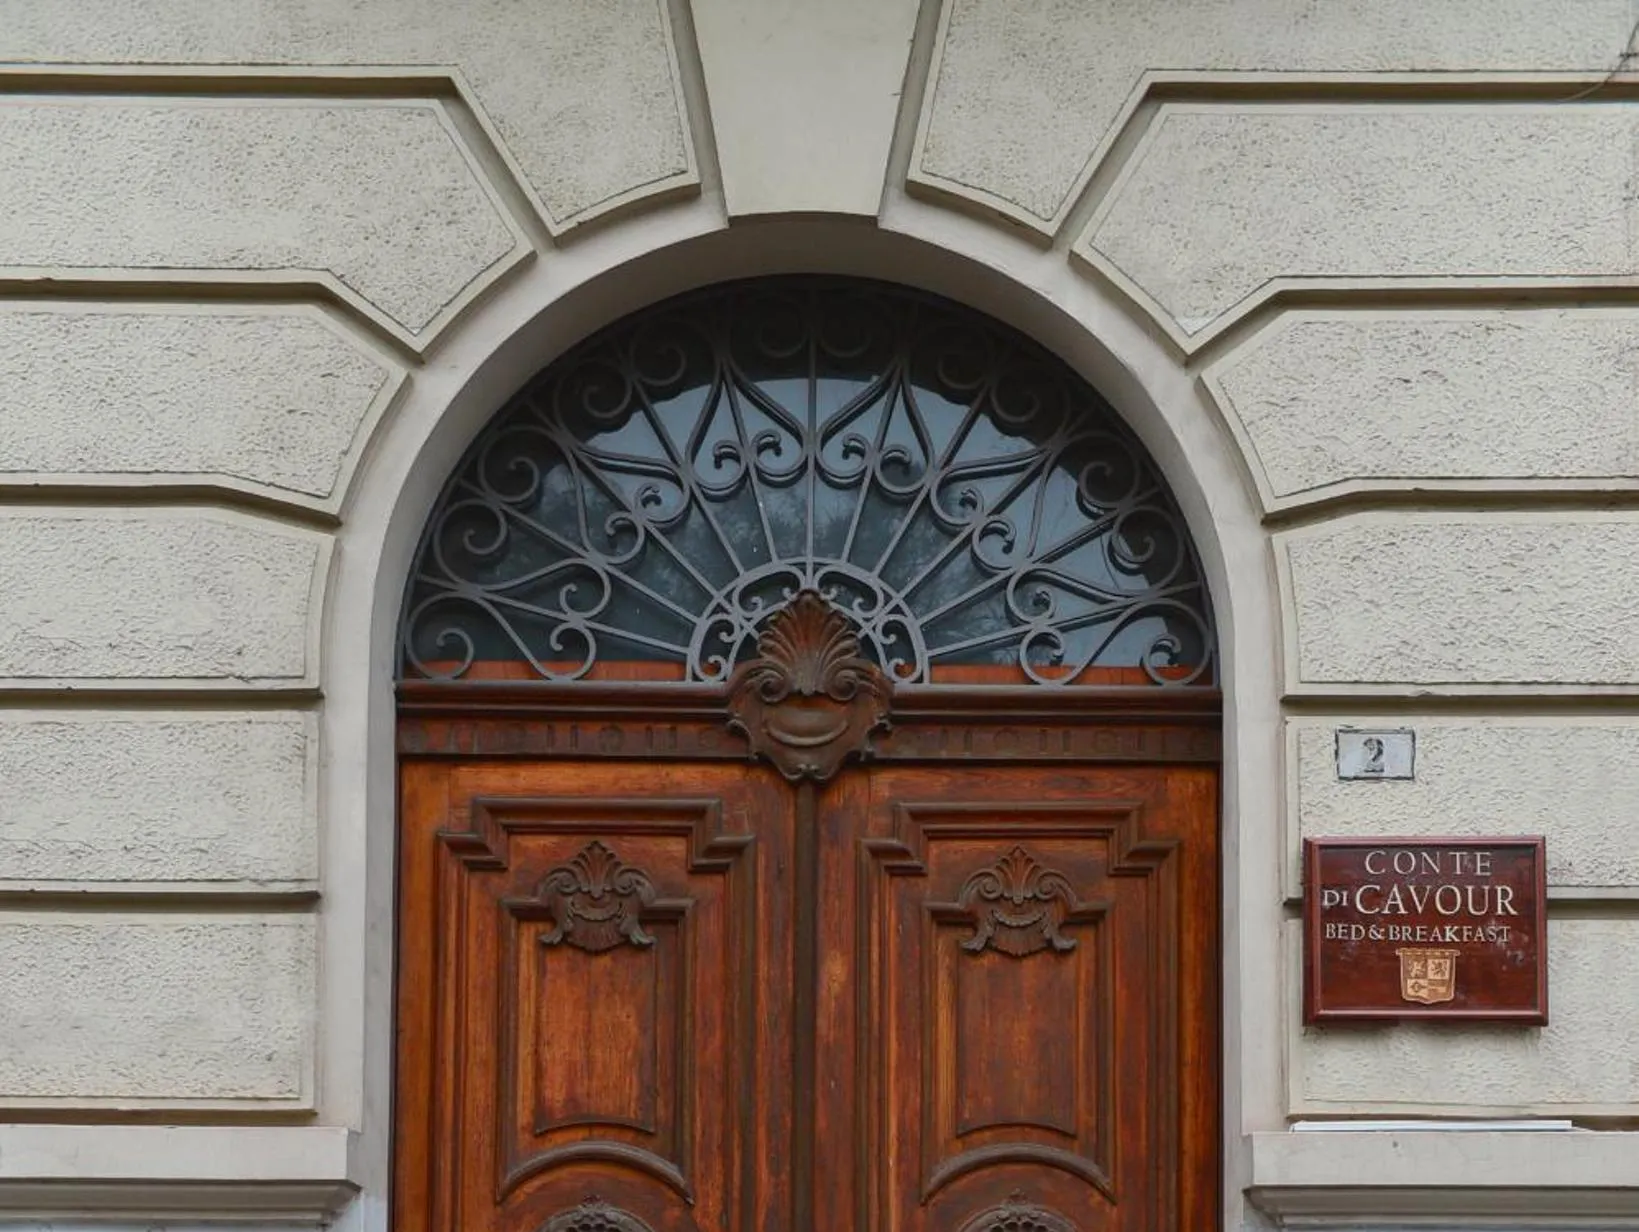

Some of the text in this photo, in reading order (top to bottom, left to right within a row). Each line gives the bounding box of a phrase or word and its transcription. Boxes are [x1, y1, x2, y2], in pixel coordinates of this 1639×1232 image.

[1363, 737, 1385, 773] 2
[1364, 850, 1493, 876] CONTE
[1322, 883, 1519, 916] DI CAVOUR
